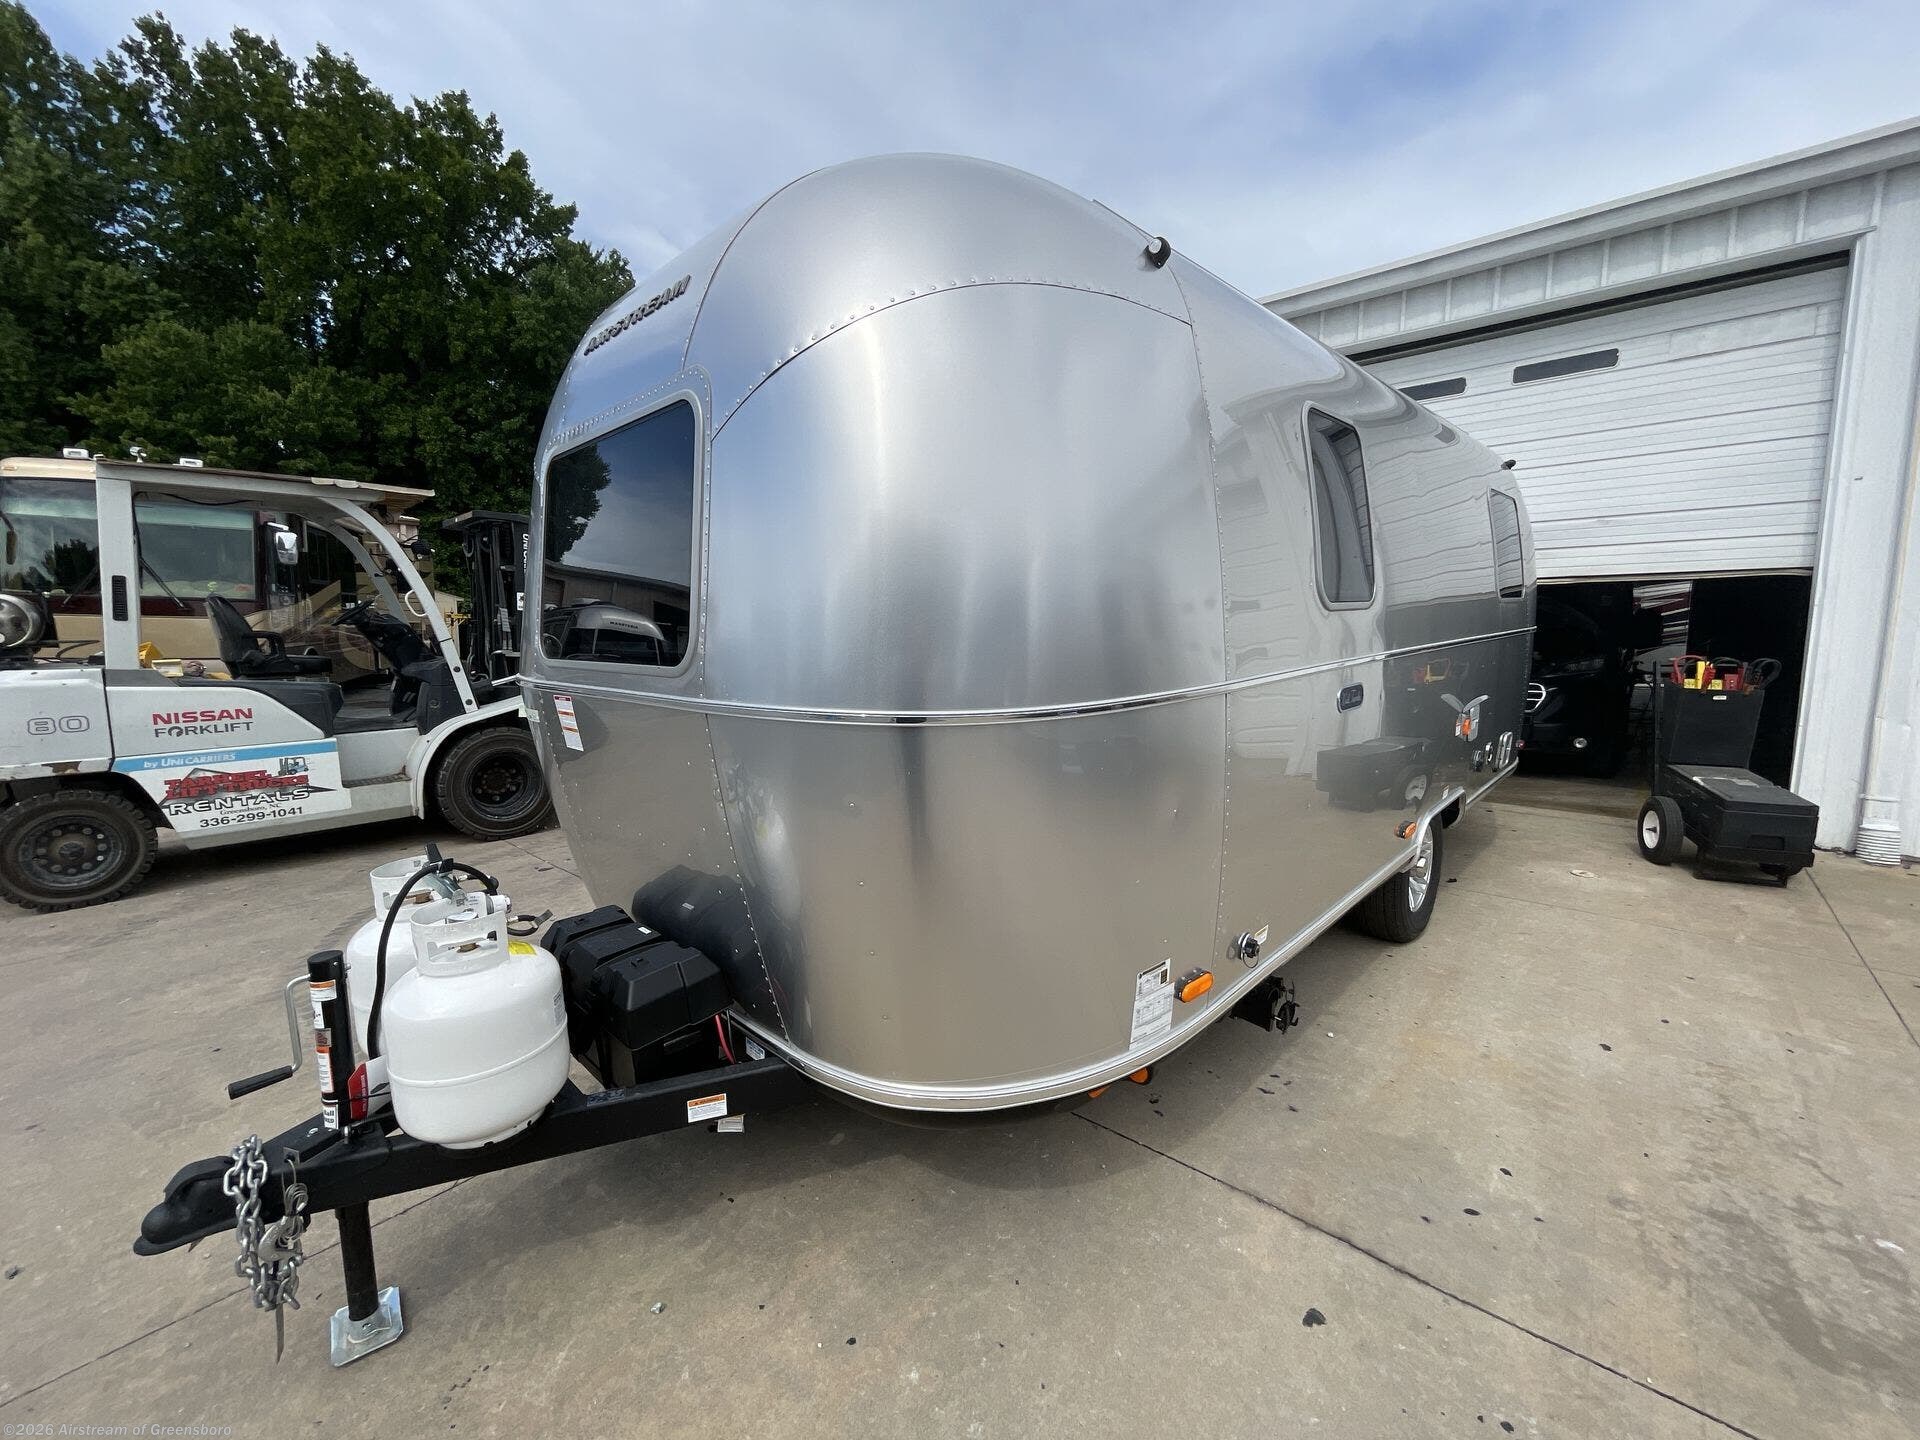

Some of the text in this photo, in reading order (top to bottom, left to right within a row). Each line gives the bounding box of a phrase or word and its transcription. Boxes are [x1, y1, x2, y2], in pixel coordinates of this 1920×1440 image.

[584, 275, 691, 356] AIRSTREAM
[27, 715, 90, 736] 80
[152, 707, 254, 726] NISSAN
[154, 721, 254, 738] FORKLIFT
[143, 761, 158, 769] by
[168, 788, 311, 816] RENTALS
[200, 806, 304, 828] 336-299-1041
